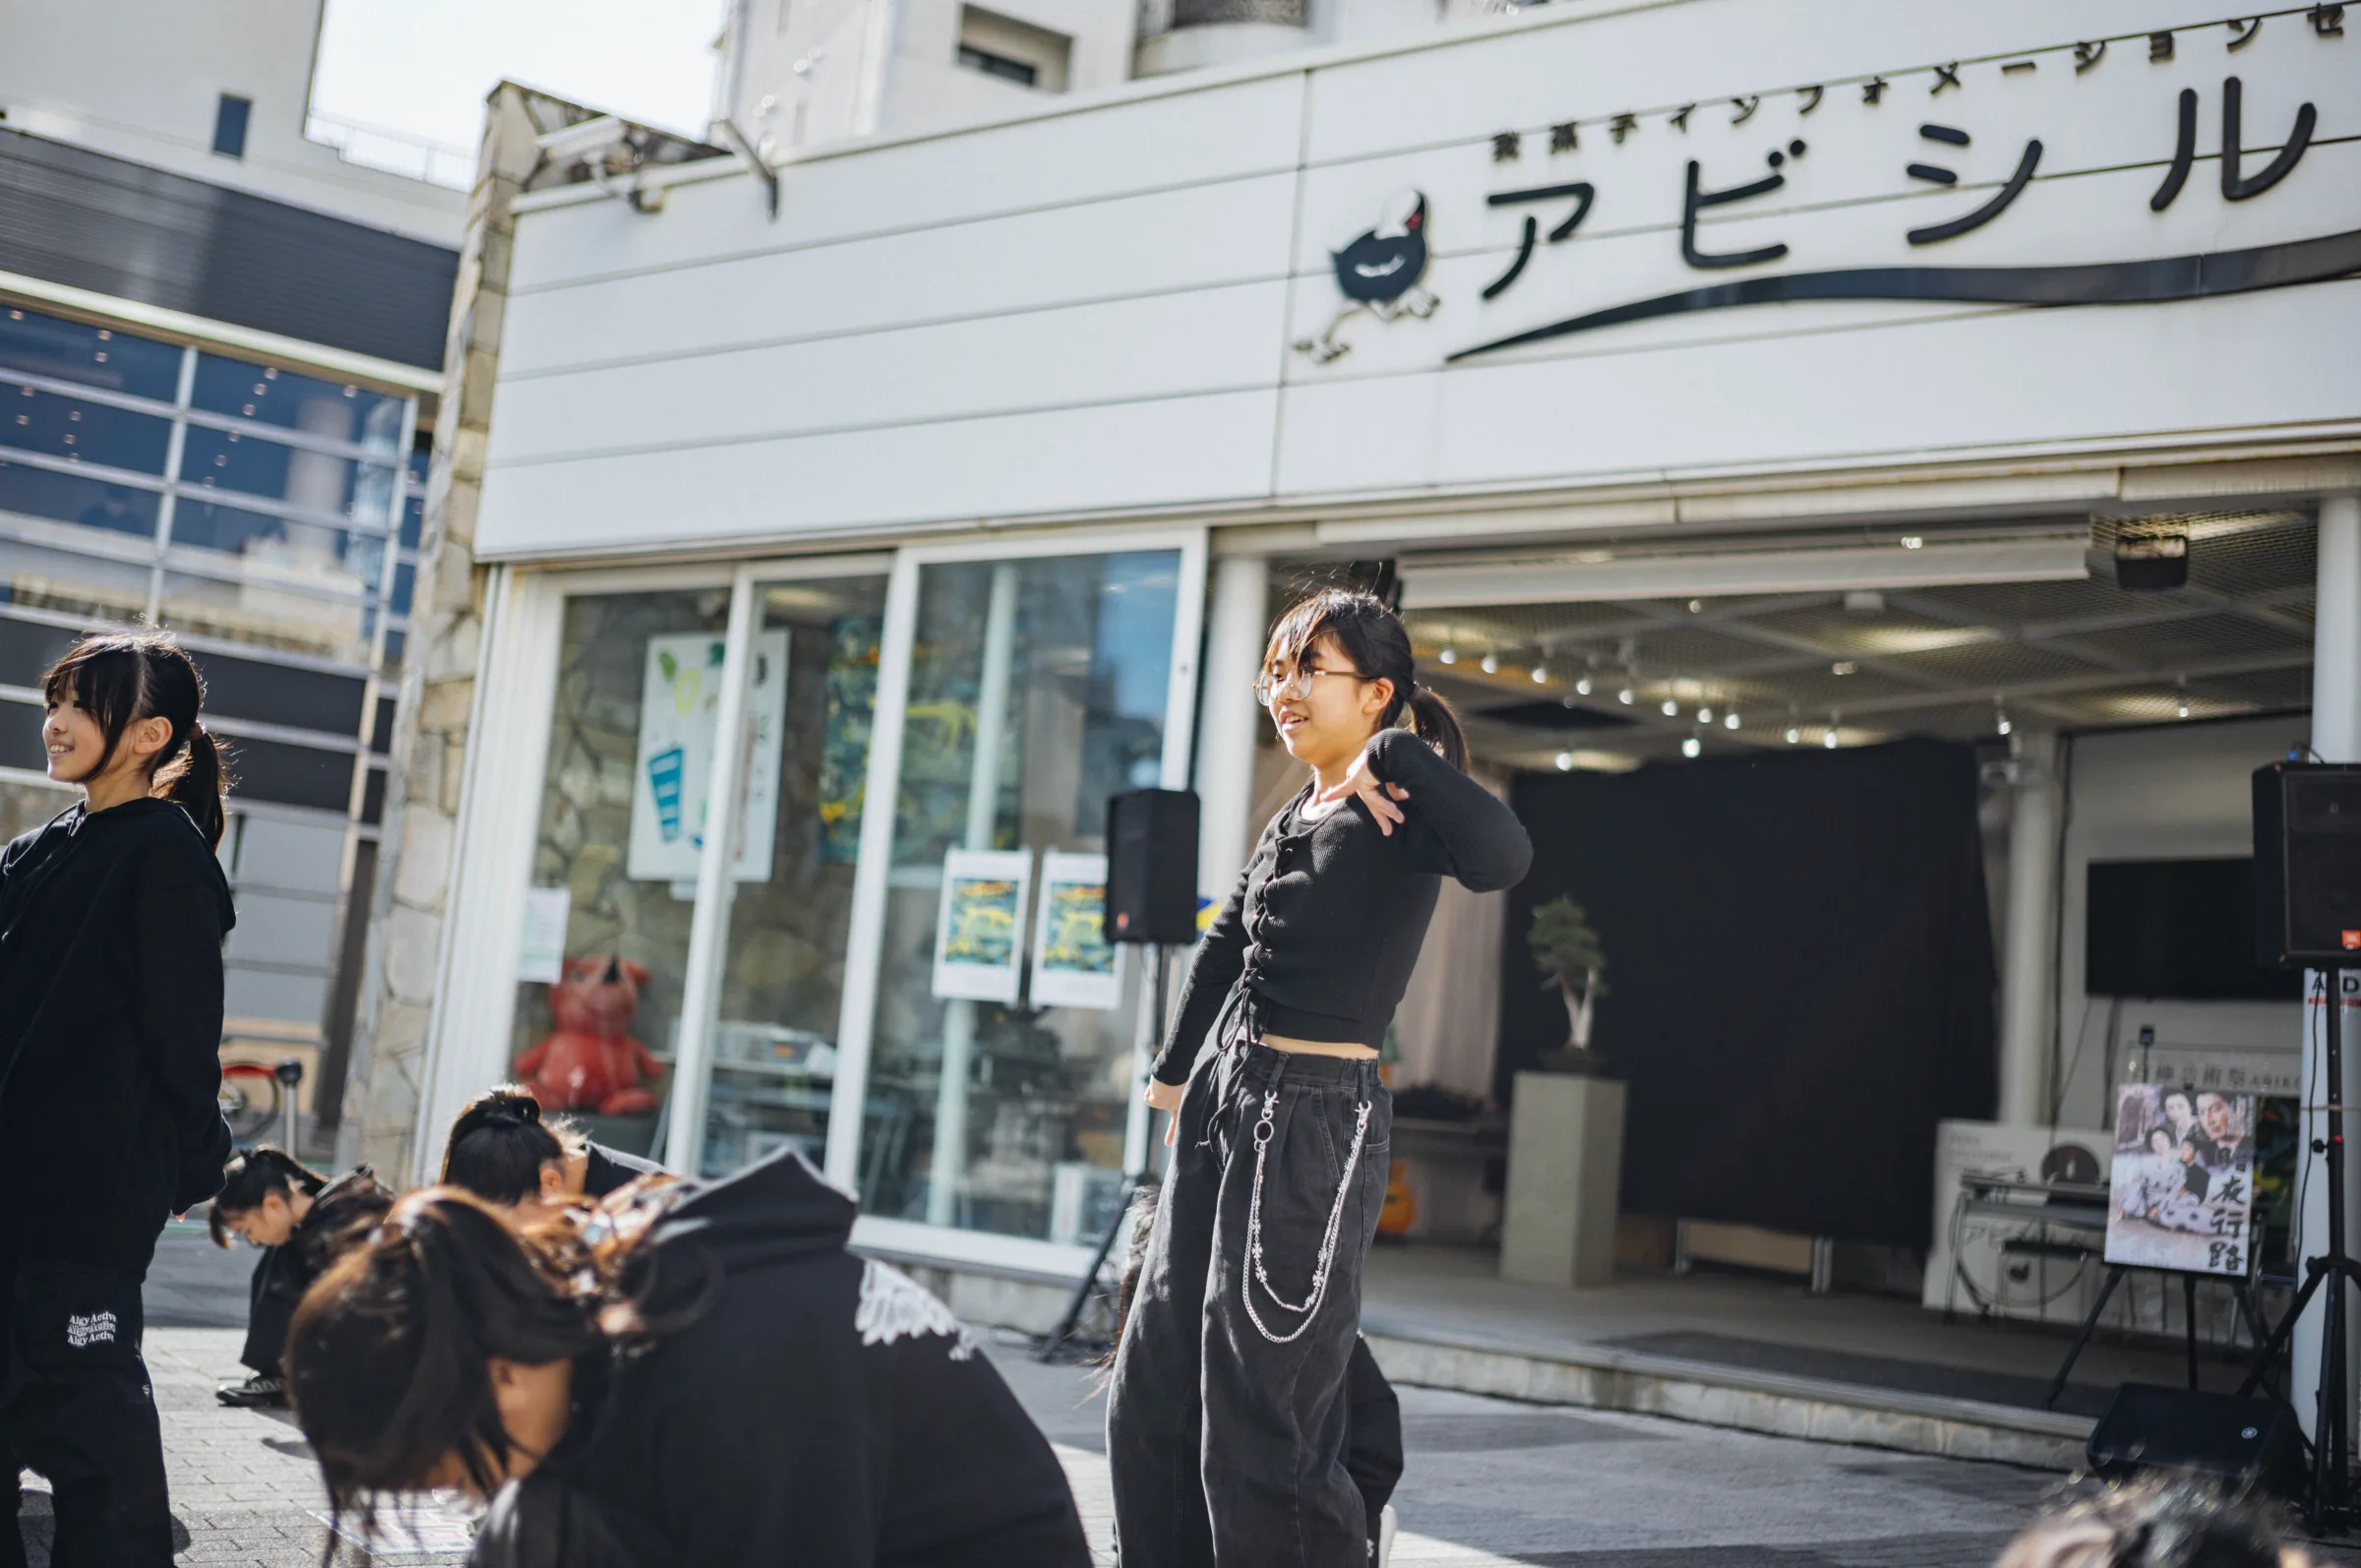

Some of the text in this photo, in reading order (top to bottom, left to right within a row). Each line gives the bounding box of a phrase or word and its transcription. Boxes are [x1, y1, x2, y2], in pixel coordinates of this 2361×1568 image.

[69, 1311, 116, 1326] Algy Active
[68, 1335, 88, 1346] Algy
